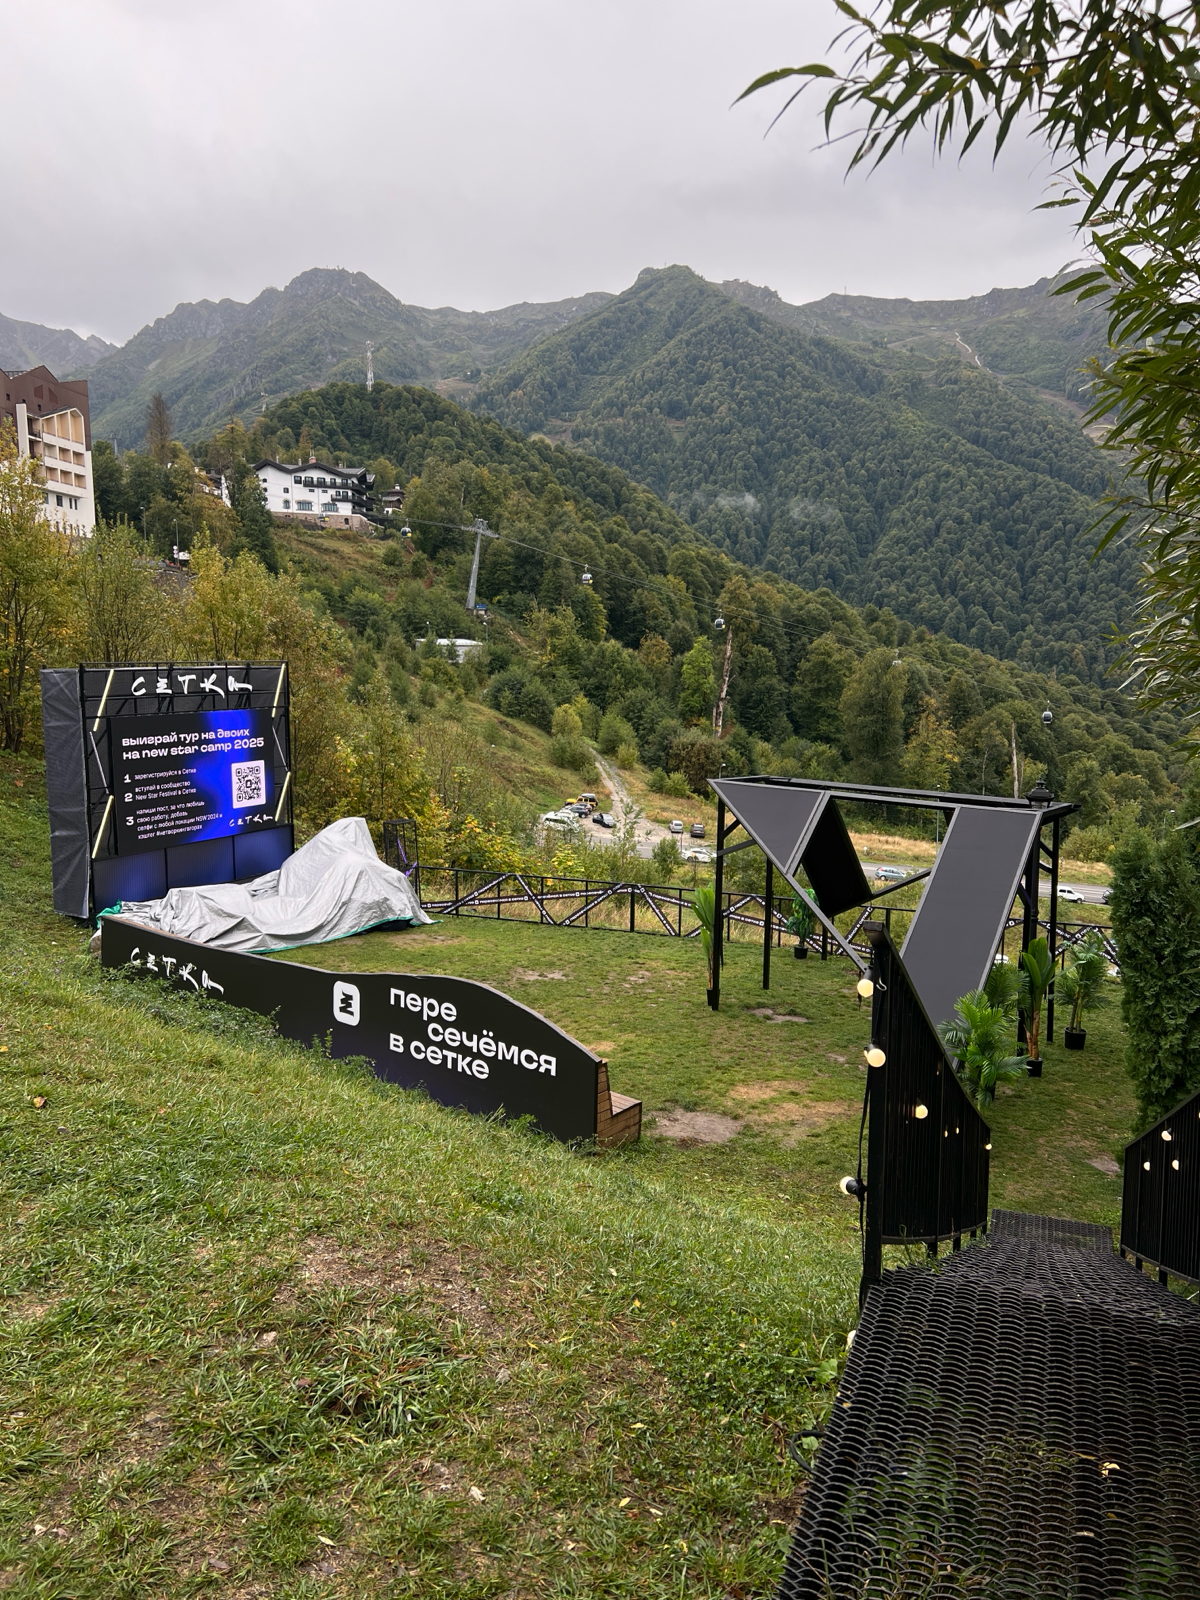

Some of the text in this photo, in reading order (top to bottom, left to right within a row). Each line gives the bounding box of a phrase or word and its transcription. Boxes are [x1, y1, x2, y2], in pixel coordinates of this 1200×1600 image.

[131, 673, 253, 698] СЕТКА
[122, 729, 249, 746] выиграй тур на двоих
[123, 738, 264, 760] на new star camp 2025
[124, 774, 131, 783] 1
[135, 770, 177, 780] зарегистрируйся
[124, 793, 133, 802] 2
[126, 816, 134, 825] 3
[137, 806, 156, 815] напиши
[130, 948, 224, 995] СЕТКА
[390, 988, 458, 1022] пере
[390, 1032, 490, 1080] в сетке
[428, 1022, 556, 1077] сечёмся
